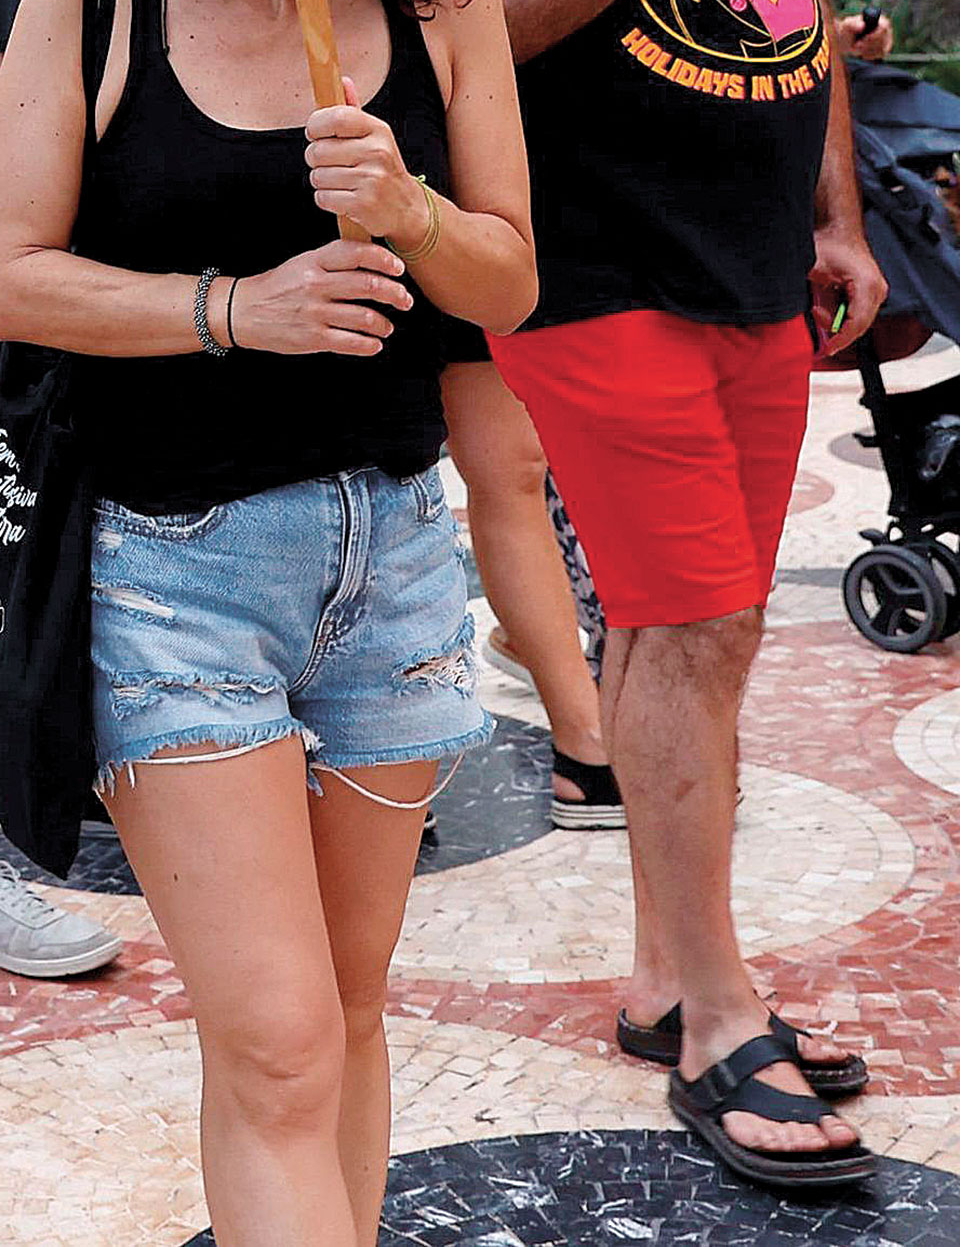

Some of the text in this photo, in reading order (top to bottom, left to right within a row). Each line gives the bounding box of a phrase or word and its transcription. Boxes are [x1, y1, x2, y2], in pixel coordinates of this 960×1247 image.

[621, 27, 745, 100] HOLIDAYS
[752, 75, 777, 101] IN
[777, 65, 816, 99] THE
